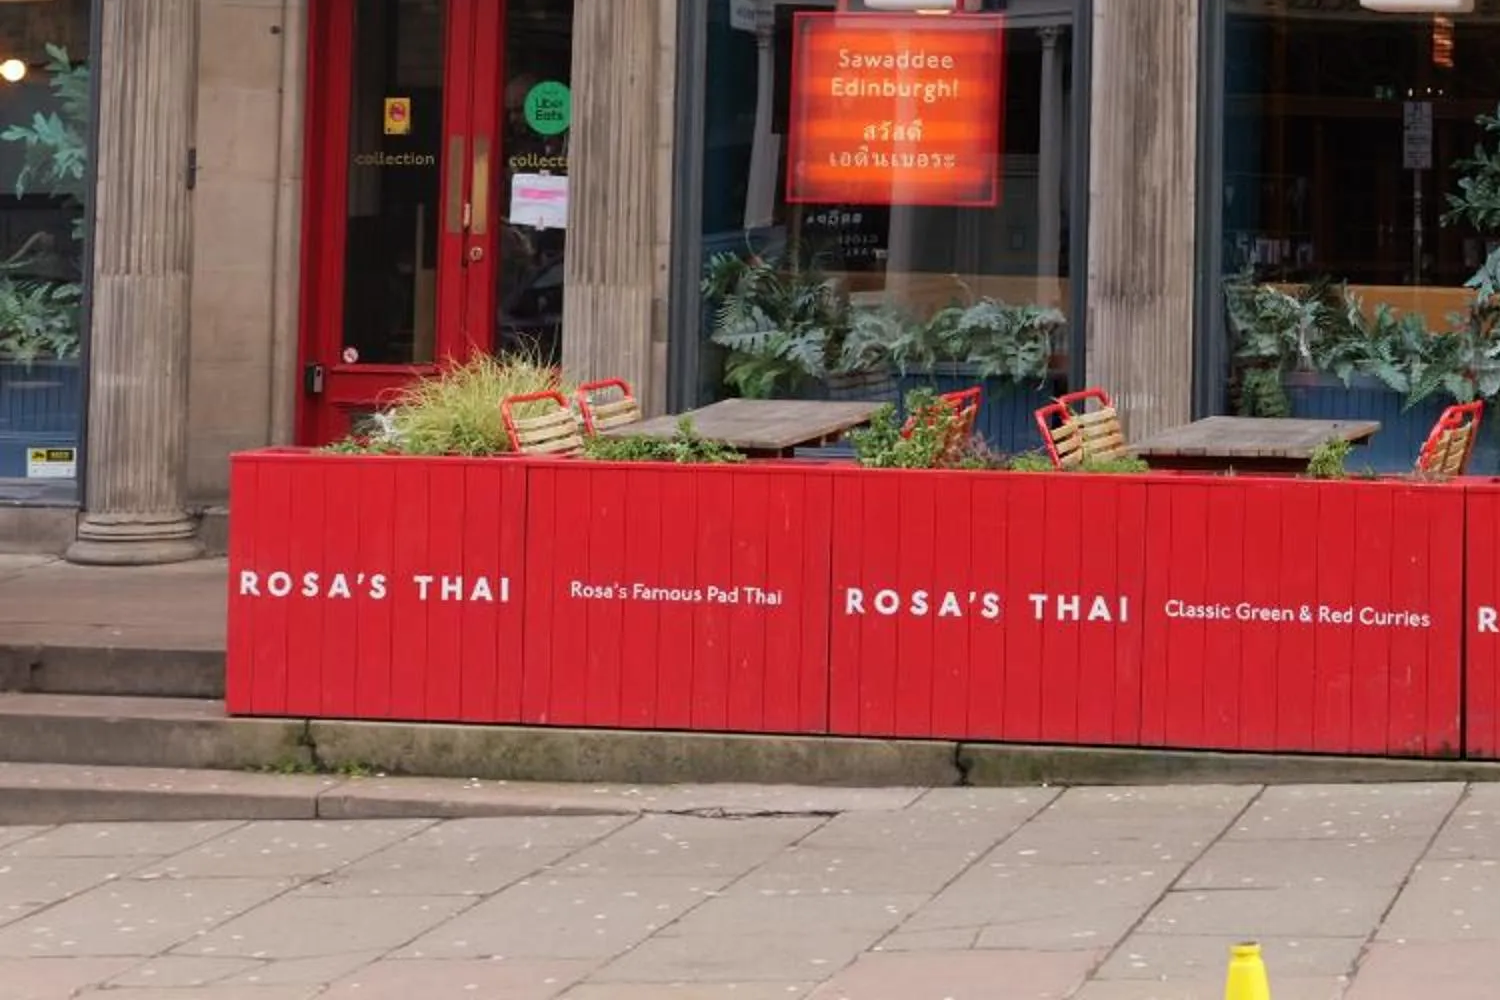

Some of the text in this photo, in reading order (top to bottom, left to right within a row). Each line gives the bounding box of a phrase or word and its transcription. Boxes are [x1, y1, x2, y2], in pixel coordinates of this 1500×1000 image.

[838, 49, 954, 69] Sawaddee
[831, 77, 959, 104] Edinburgh!
[535, 109, 563, 121] Eats
[354, 151, 435, 167] collection
[240, 571, 510, 603] ROSA'S THAI
[571, 581, 783, 606] Rosa's Famous Pad Thai
[846, 588, 1129, 623] ROSA'S THAI
[1165, 600, 1431, 628] Classic Green & Red Curries
